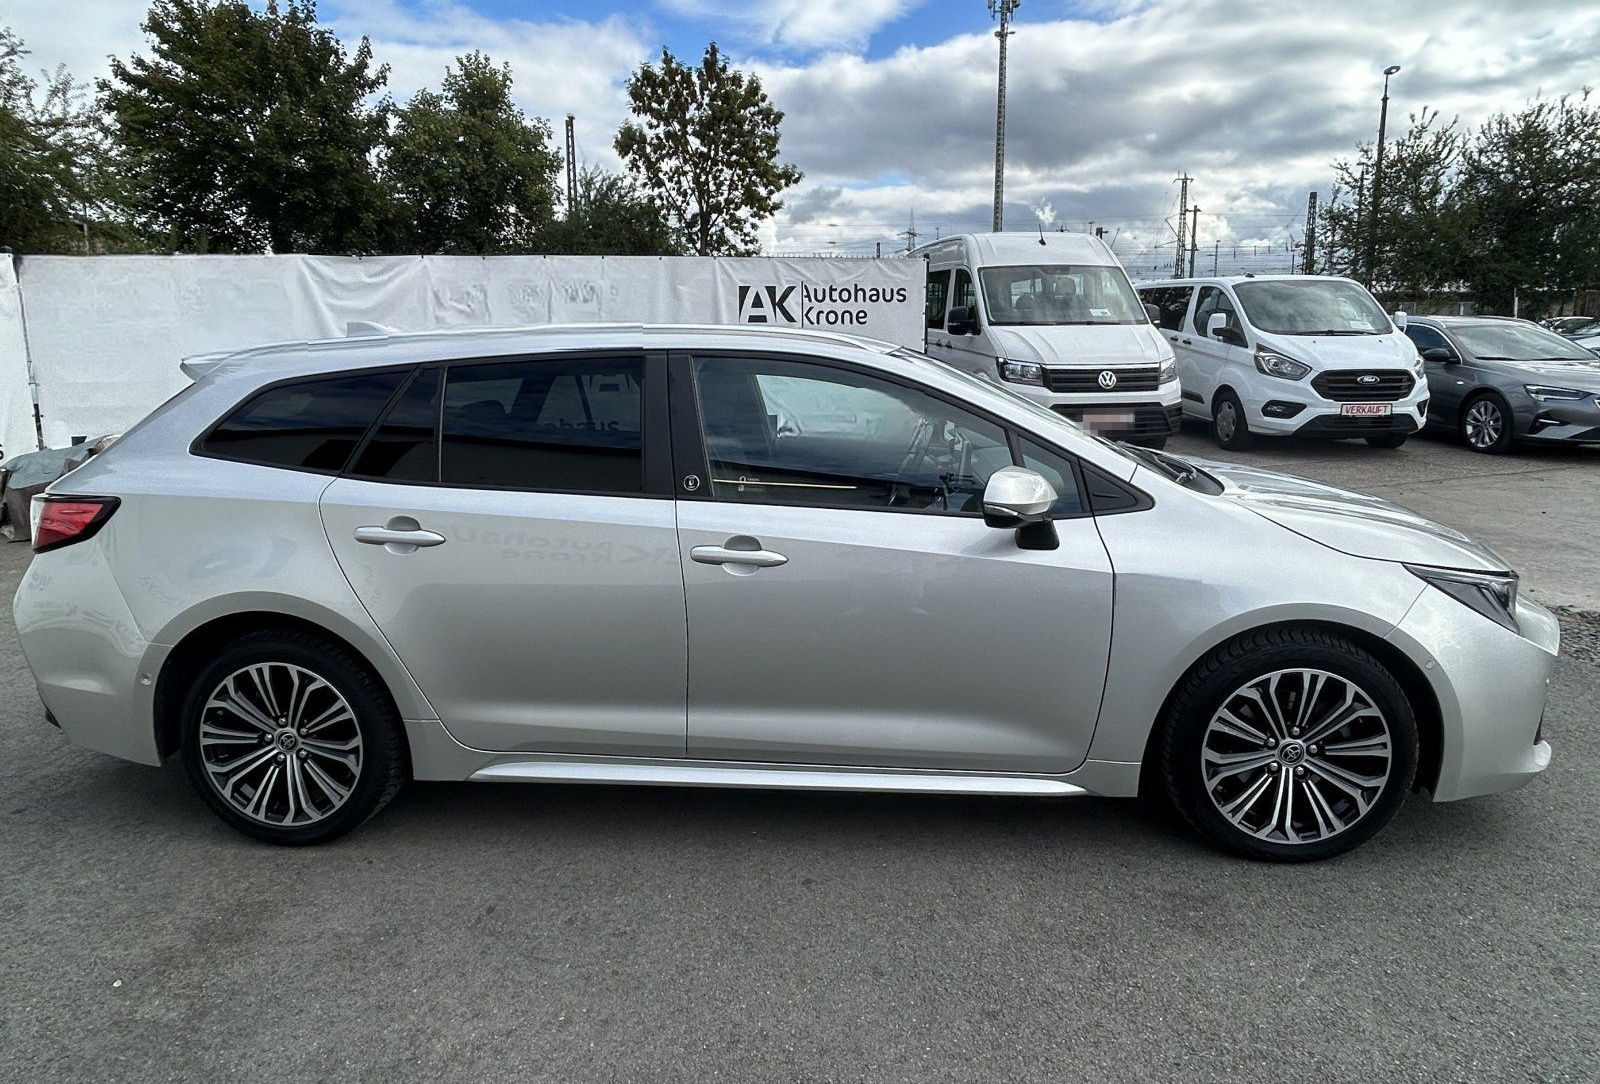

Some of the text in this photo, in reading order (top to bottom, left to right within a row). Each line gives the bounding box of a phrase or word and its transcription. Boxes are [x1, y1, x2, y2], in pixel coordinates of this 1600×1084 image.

[803, 284, 907, 303] Autohaus
[738, 285, 797, 323] AK
[804, 306, 868, 325] Krone
[1345, 405, 1388, 414] VERKAUFT
